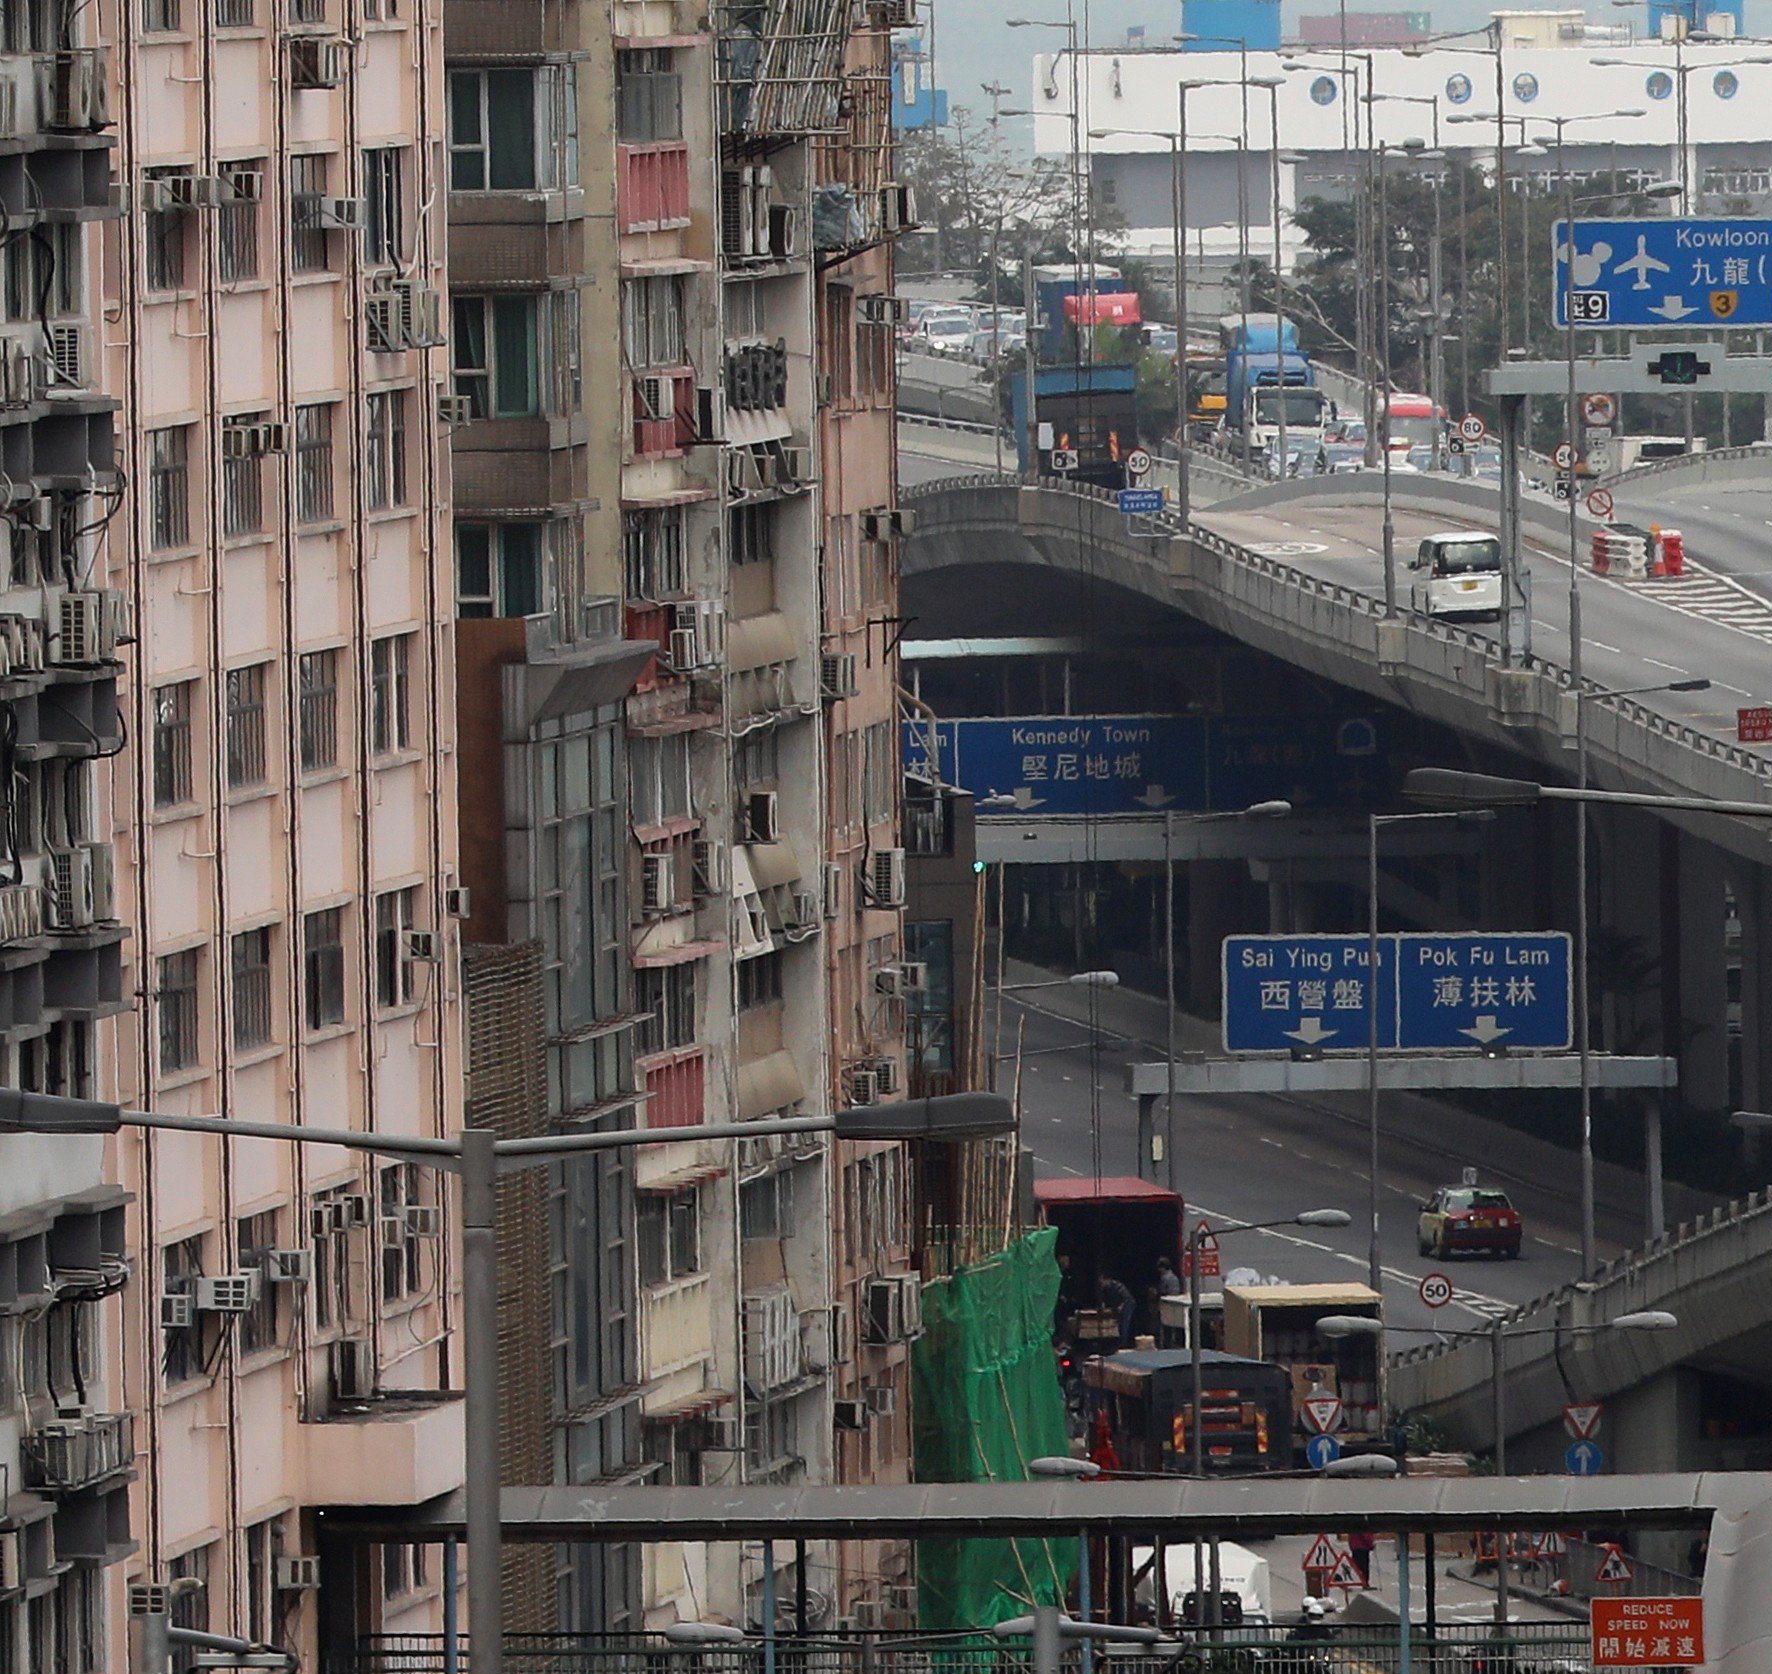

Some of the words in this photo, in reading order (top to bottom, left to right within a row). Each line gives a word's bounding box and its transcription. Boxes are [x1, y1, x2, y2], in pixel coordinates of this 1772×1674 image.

[1676, 228, 1769, 248] Kowloon
[1589, 295, 1603, 317] 9
[1713, 294, 1732, 313] 3
[1130, 456, 1148, 468] 50
[1012, 726, 1091, 748] Kennedy
[1102, 725, 1150, 743] Town
[1021, 752, 1142, 782] 堅尼地城
[1241, 948, 1274, 968] Sai
[1286, 948, 1333, 972] Ying
[1419, 946, 1458, 967] Pok
[1470, 946, 1495, 966] Fu
[1505, 946, 1550, 966] Lam
[1259, 978, 1364, 1011] 西營盤
[1432, 975, 1537, 1008] 薄扶林
[1425, 1283, 1447, 1299] 50
[1622, 1604, 1674, 1616] REDUCE
[1607, 1619, 1648, 1631] SPEED
[1659, 1618, 1690, 1630] NOW
[1599, 1636, 1696, 1658] 開始減速
